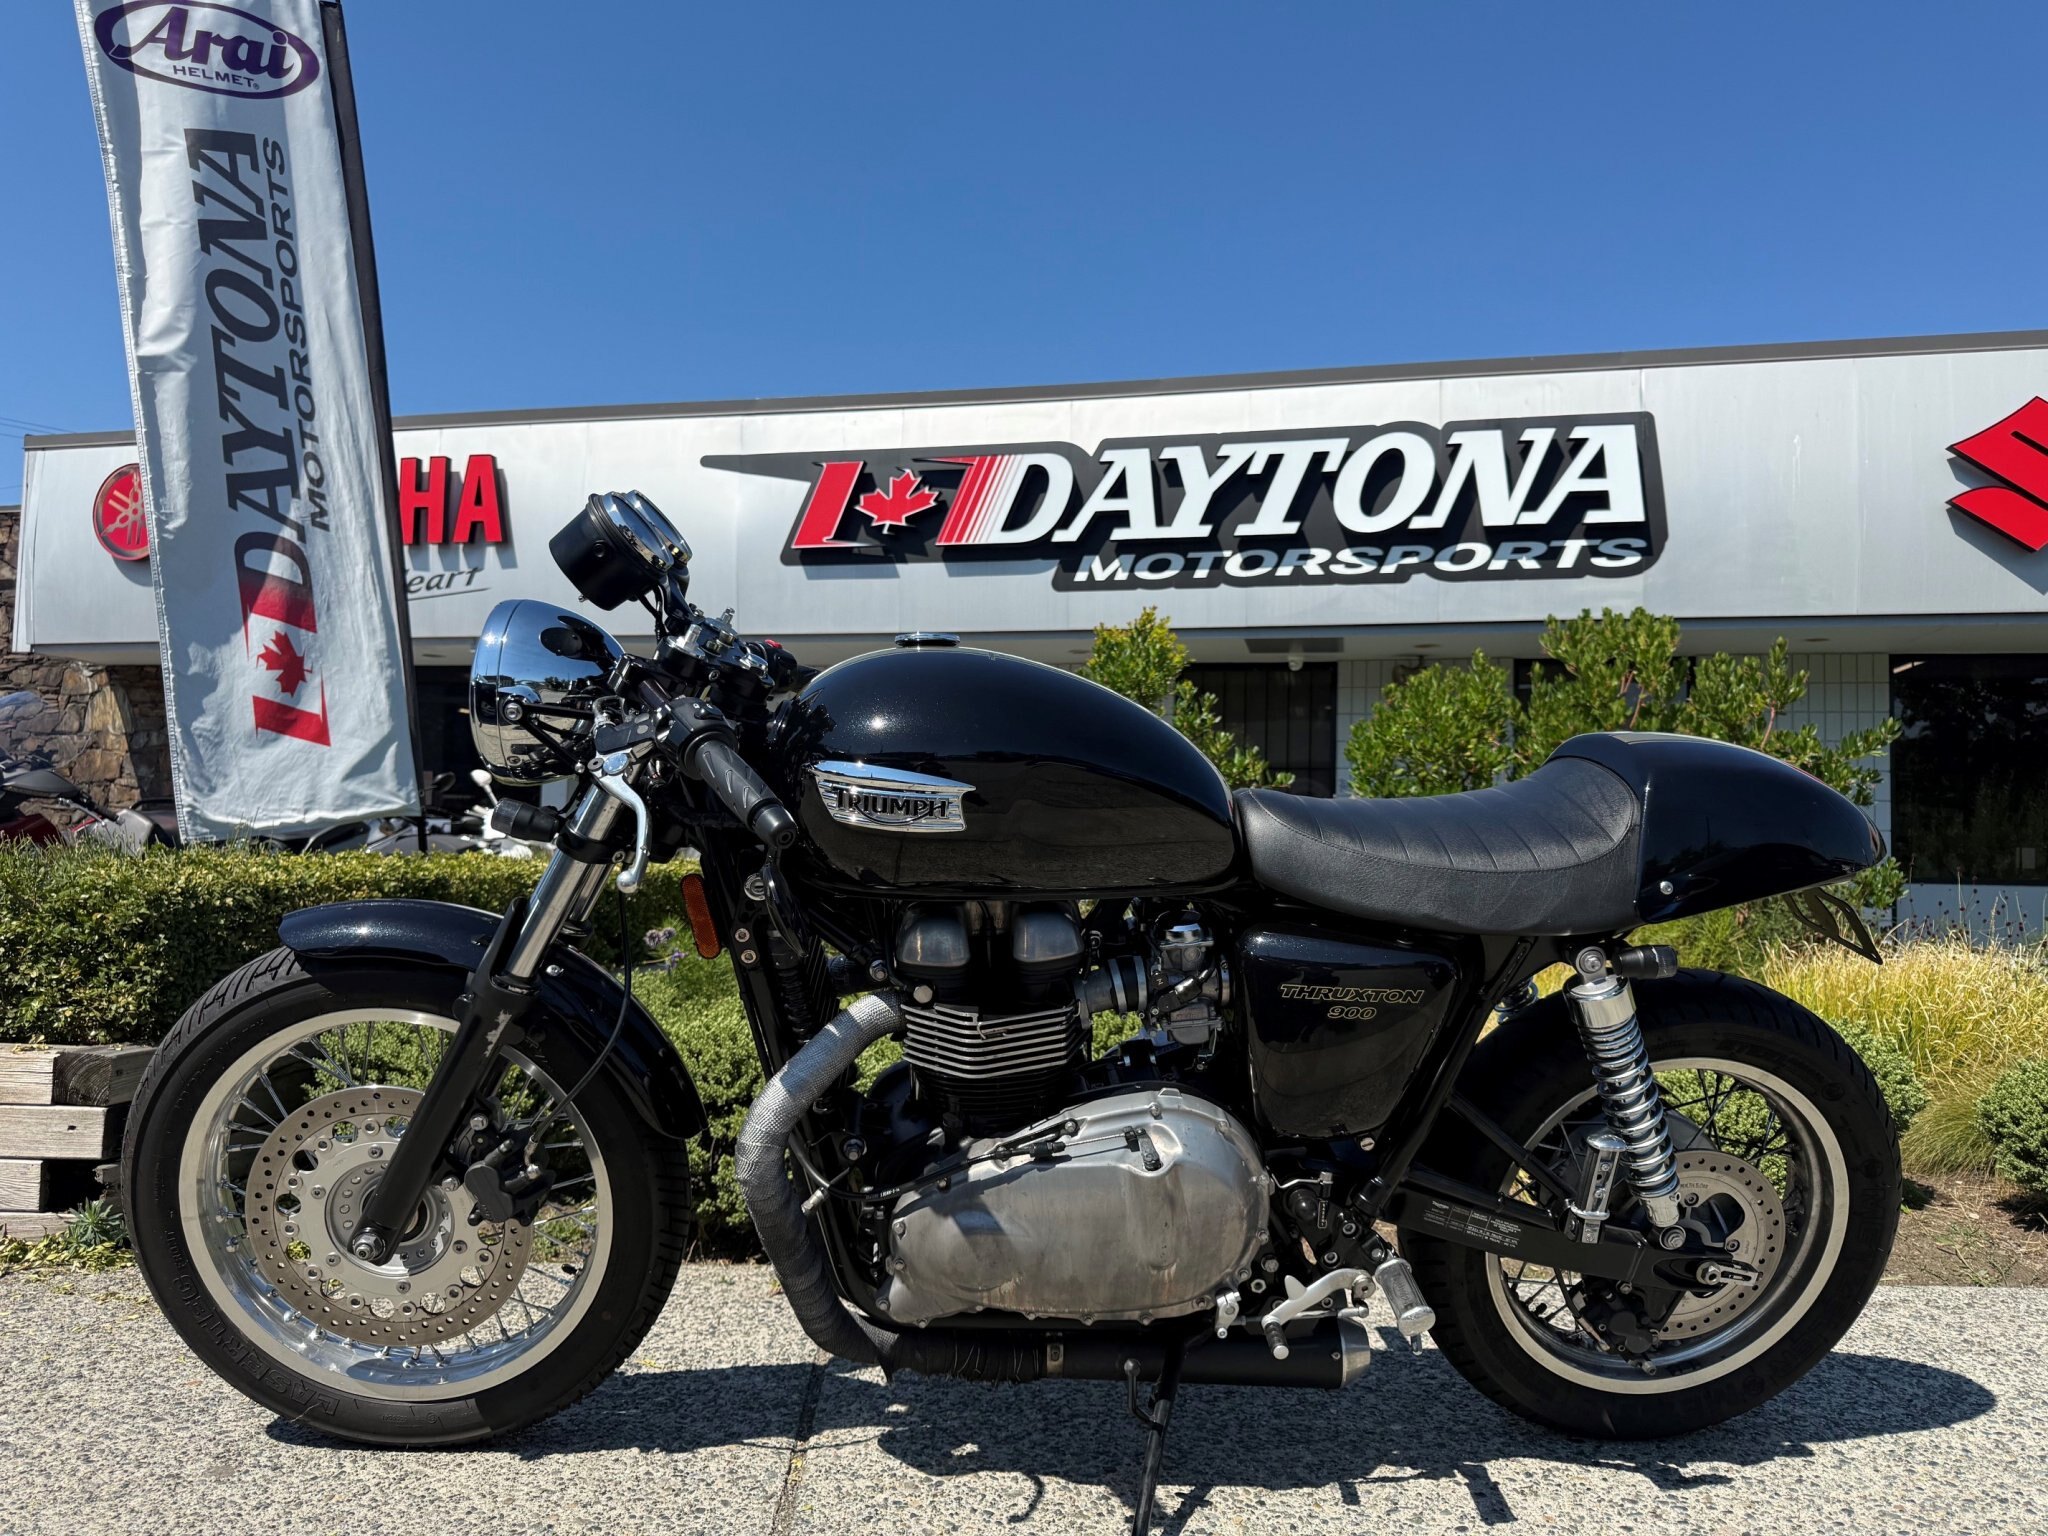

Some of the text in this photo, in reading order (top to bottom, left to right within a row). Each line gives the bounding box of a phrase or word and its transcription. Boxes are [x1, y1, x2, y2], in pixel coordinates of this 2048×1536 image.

[108, 6, 295, 79] Arai
[172, 64, 256, 88] HELMET
[262, 136, 331, 532] MOTORSPORTS
[184, 127, 318, 635] DAYTONA
[934, 423, 1647, 546] DAYTONA
[1073, 537, 1648, 582] MOTORSPORTS
[403, 566, 483, 594] eart
[837, 788, 950, 821] TRIUMPH
[1279, 983, 1425, 1004] THRUXTON
[1327, 1005, 1377, 1021] 900
